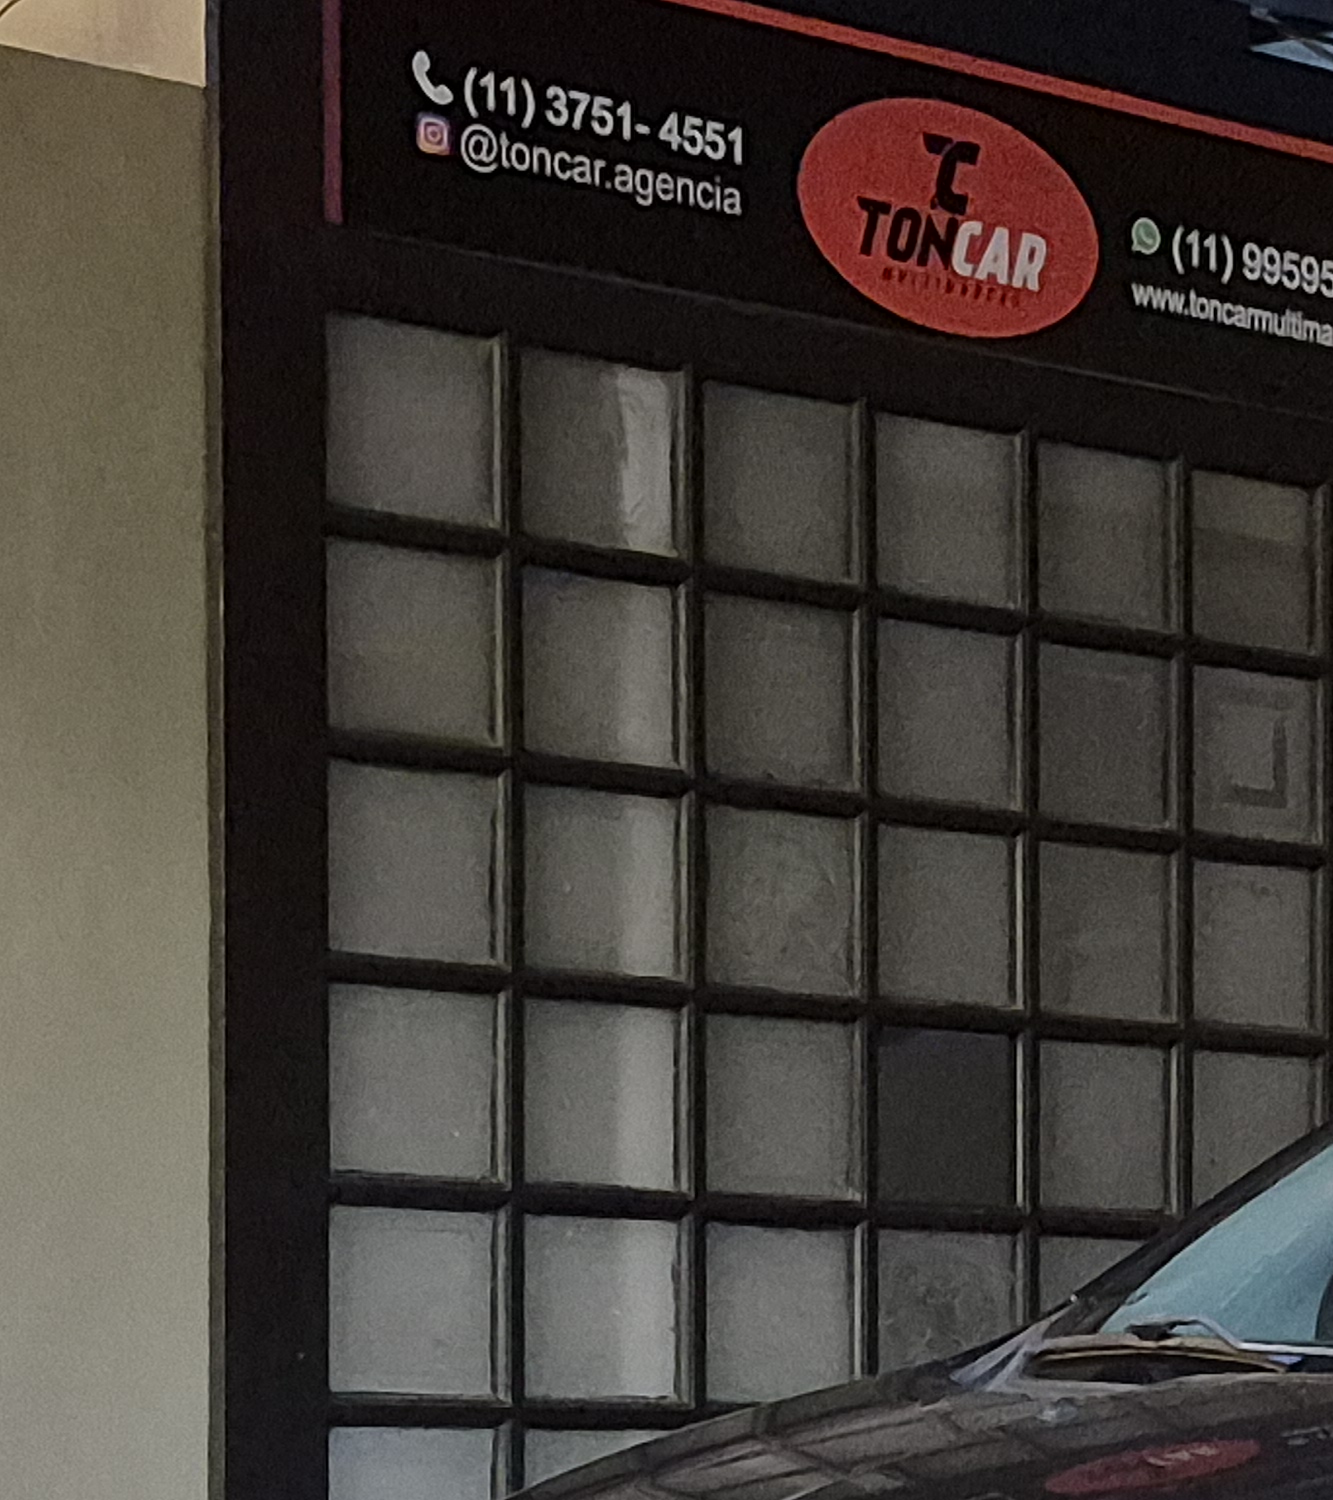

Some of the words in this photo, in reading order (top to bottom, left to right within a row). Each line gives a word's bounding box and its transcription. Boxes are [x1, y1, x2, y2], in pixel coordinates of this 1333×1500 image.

[464, 67, 535, 128] (11)
[460, 123, 742, 215] @toncar.agencia
[857, 195, 1048, 291] TONCAR
[1172, 225, 1234, 284] (11)
